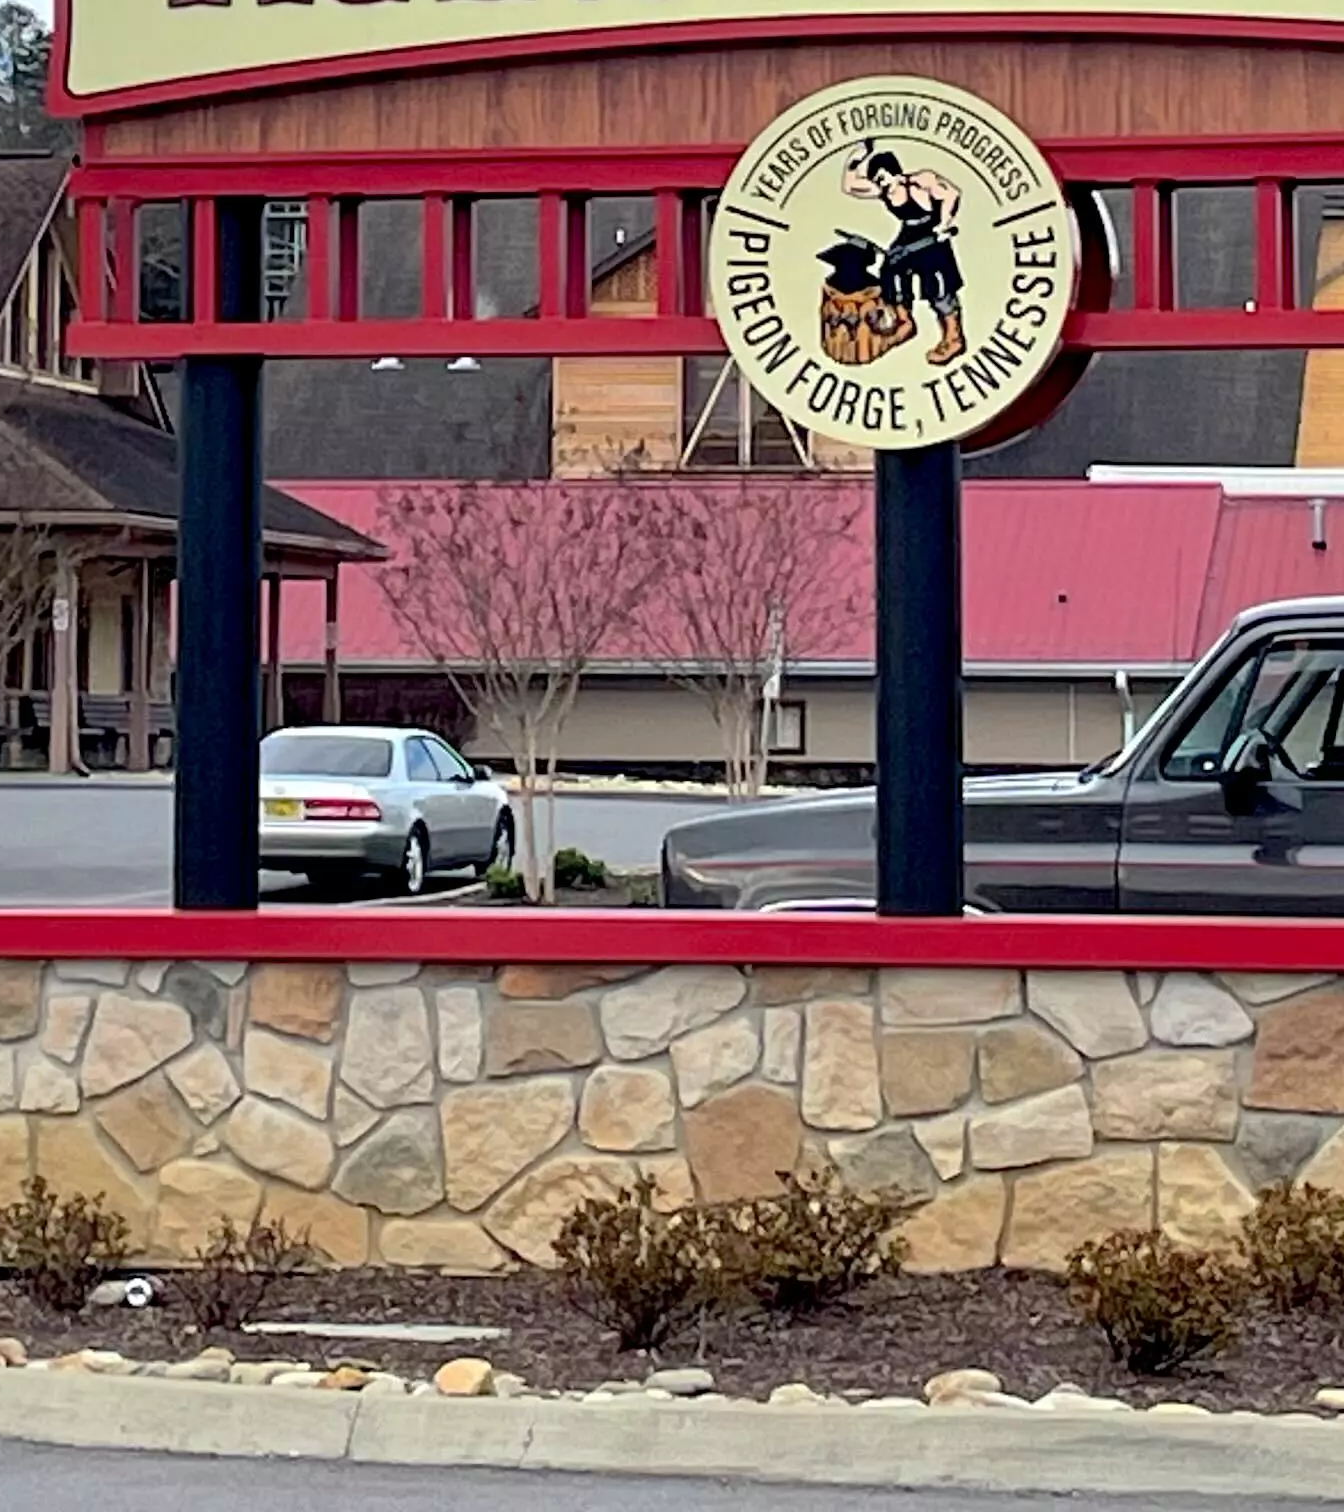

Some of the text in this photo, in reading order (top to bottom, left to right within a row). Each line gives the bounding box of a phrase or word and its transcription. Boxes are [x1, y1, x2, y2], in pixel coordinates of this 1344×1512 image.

[753, 103, 1031, 203] YEARS OF FORGING PROGRESS
[727, 230, 798, 375] PIGEON
[921, 225, 1057, 422] TENNESSEE
